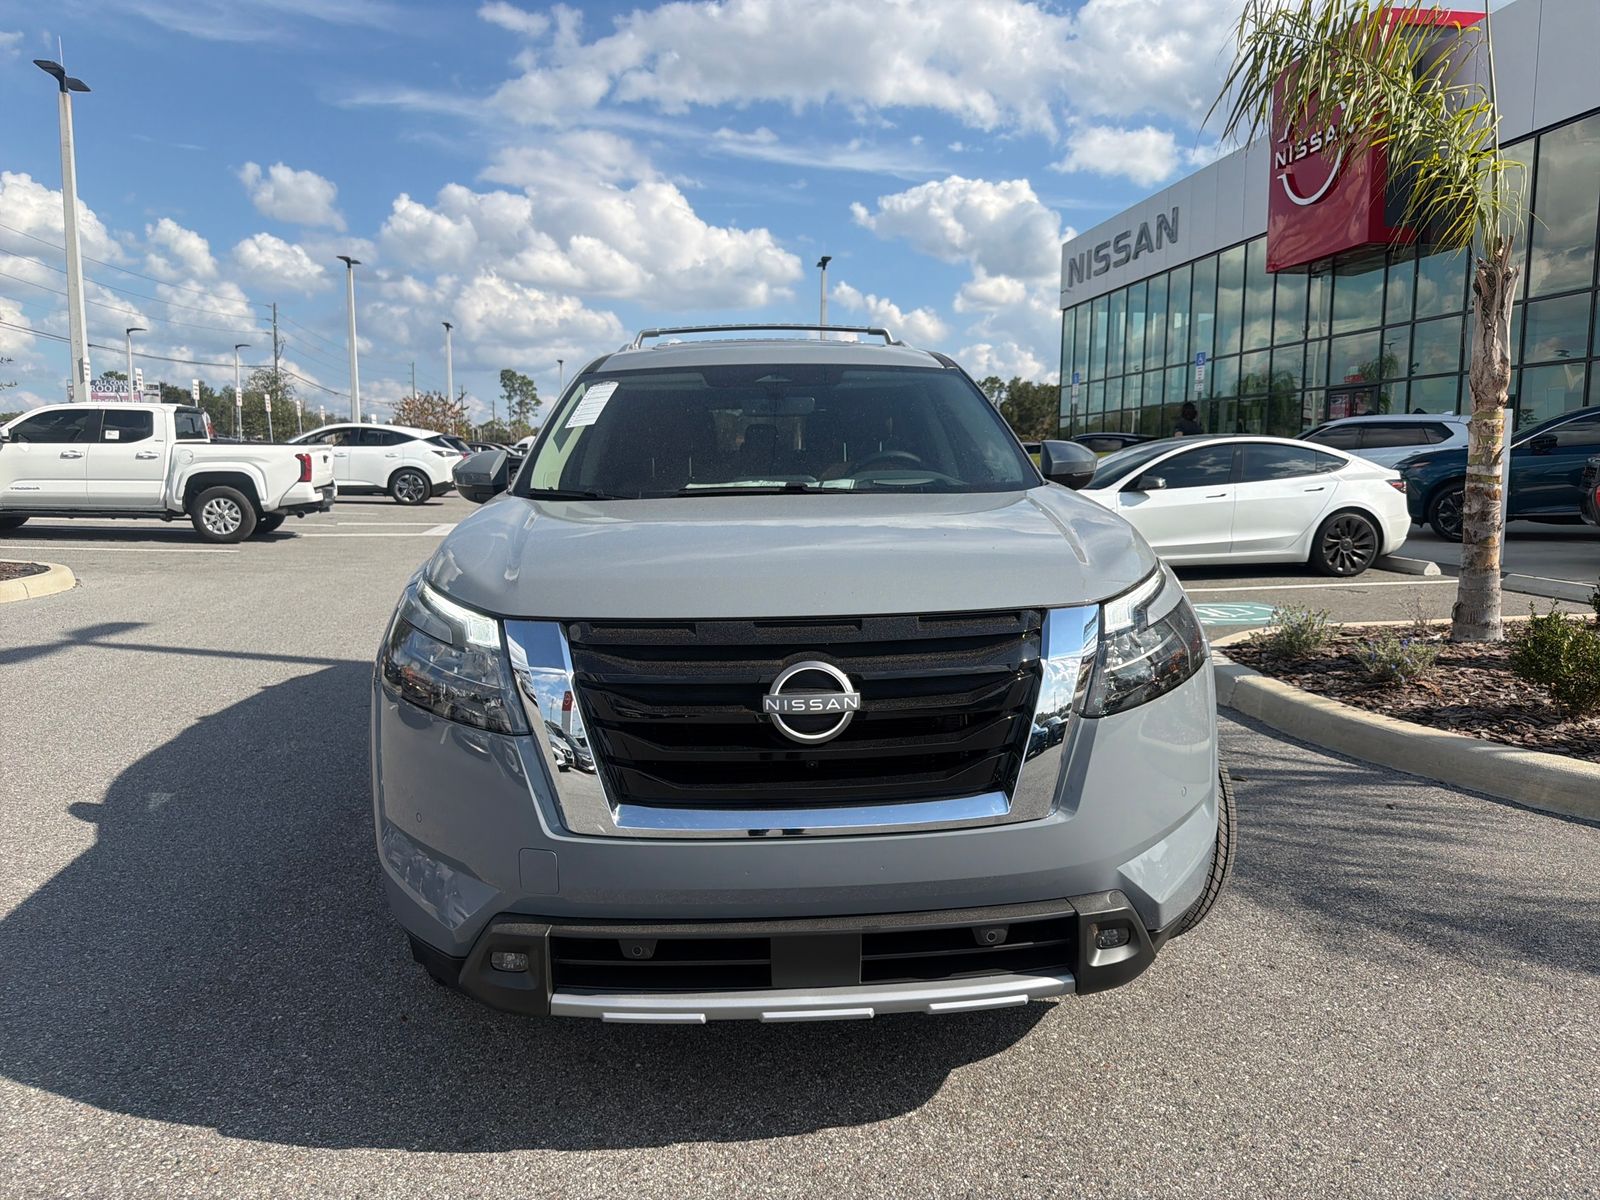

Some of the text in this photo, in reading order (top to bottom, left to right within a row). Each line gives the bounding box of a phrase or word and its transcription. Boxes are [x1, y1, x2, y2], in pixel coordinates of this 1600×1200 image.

[1275, 118, 1355, 169] NISSA
[1067, 206, 1179, 288] NISSAN
[765, 696, 858, 711] NISSAN
